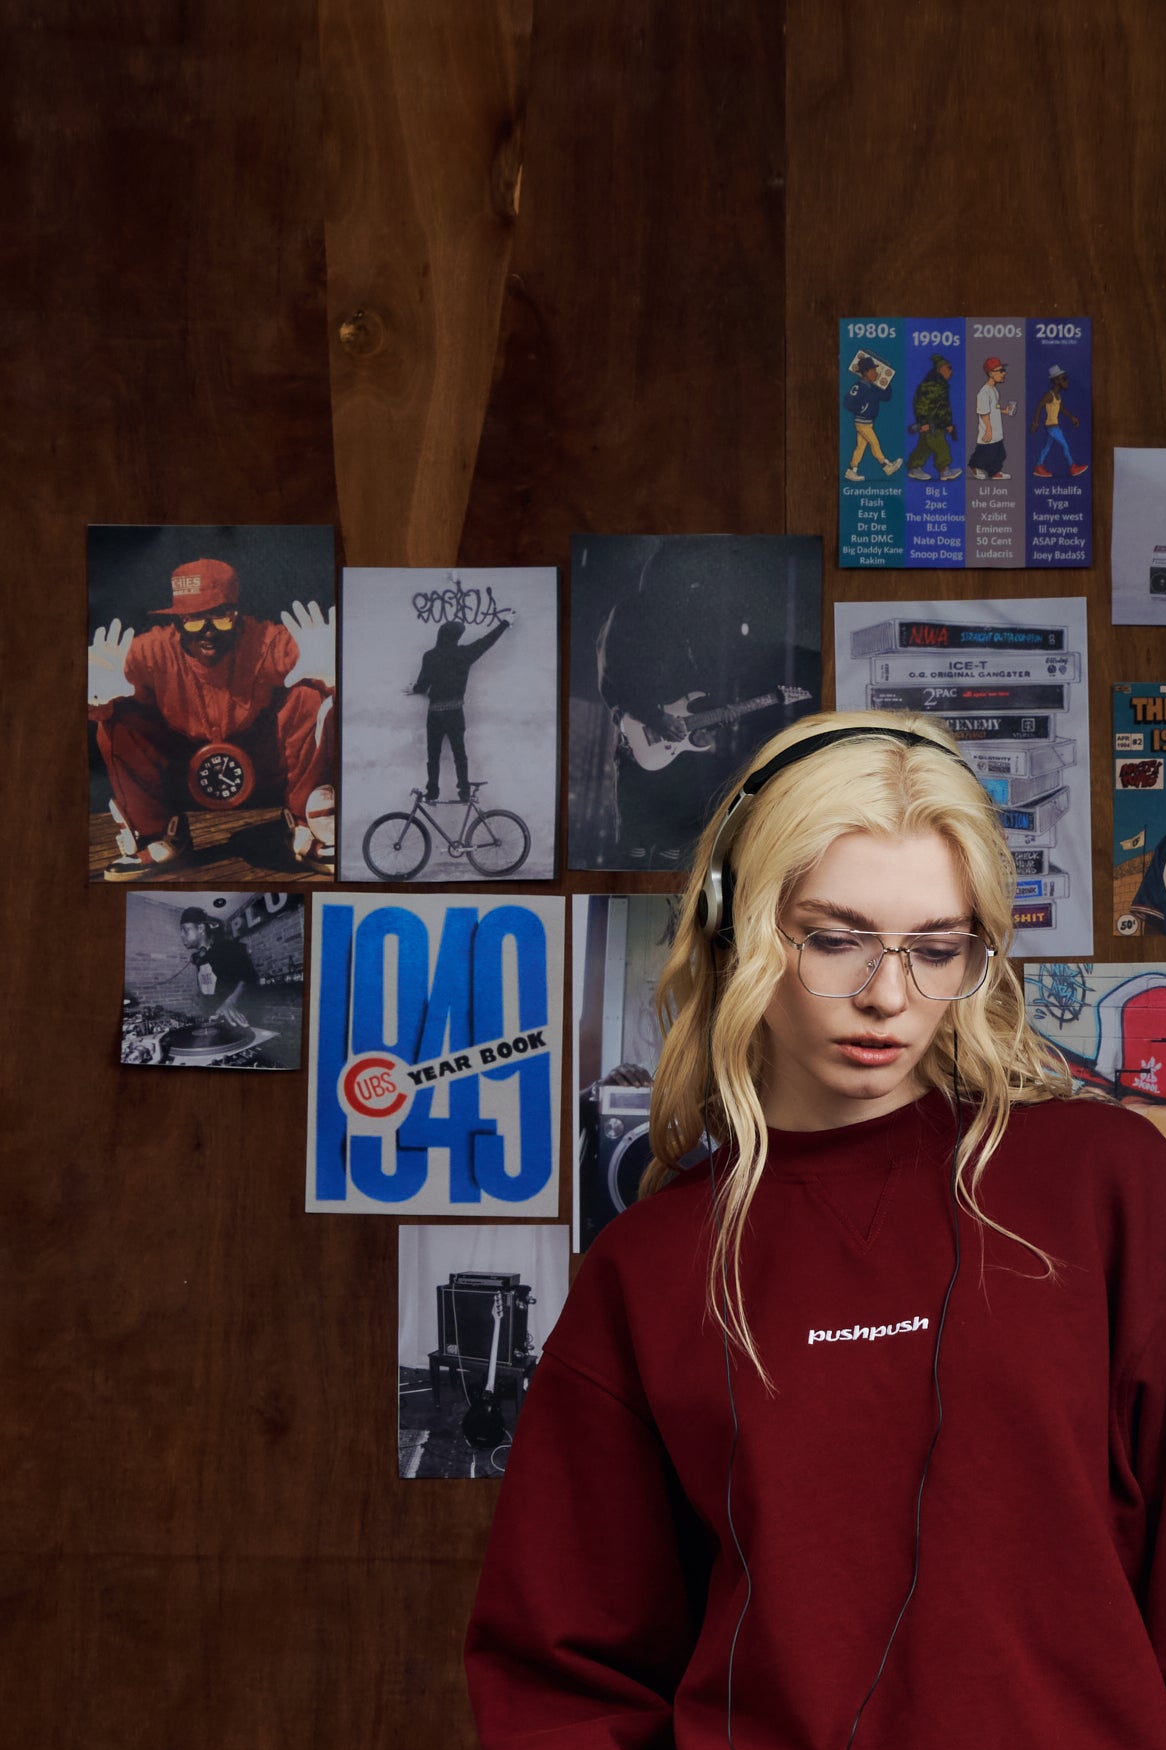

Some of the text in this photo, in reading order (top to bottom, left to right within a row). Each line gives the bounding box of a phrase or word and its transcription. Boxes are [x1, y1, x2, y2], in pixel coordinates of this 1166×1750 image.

[848, 323, 896, 338] 1980s
[973, 323, 1022, 338] 2000s
[1036, 323, 1082, 338] 2010s
[912, 331, 960, 346] 1990s
[843, 487, 902, 496] Grandmaster
[925, 487, 948, 497] Big L
[979, 487, 1008, 495] Lil Jon
[1051, 486, 1082, 495] khalifa
[860, 498, 885, 507] Flash
[924, 501, 947, 511] 2pac
[971, 499, 1015, 508] the Game
[1047, 499, 1069, 510] Tyga
[858, 510, 887, 520] Eazy E
[906, 513, 965, 522] The Notorious
[980, 513, 1007, 521] Xzibit
[1033, 512, 1083, 523] kanye west
[857, 522, 887, 531] Dr Dre
[976, 525, 1012, 533] Eminem
[1039, 525, 1078, 536] lil wayne
[851, 535, 894, 543] Run DMC
[913, 536, 961, 547] Nate Dogg
[976, 537, 1012, 545] 50 Cent
[1032, 537, 1085, 547] ASAP Rocky
[843, 546, 903, 555] Big Daddy Kane
[910, 549, 963, 561] Snoop Dogg
[976, 549, 1013, 558] Ludacris
[860, 556, 886, 565] Rakim
[1032, 551, 1053, 561] Joey
[949, 661, 987, 671] ICE-T
[930, 671, 975, 679] ORIGINAL
[977, 671, 1031, 679] GANGSTER
[923, 688, 958, 707] 2PAC
[954, 718, 1002, 732] ENEMY
[407, 1030, 547, 1086] YEAR BOOK
[807, 1316, 930, 1345] pushpush
